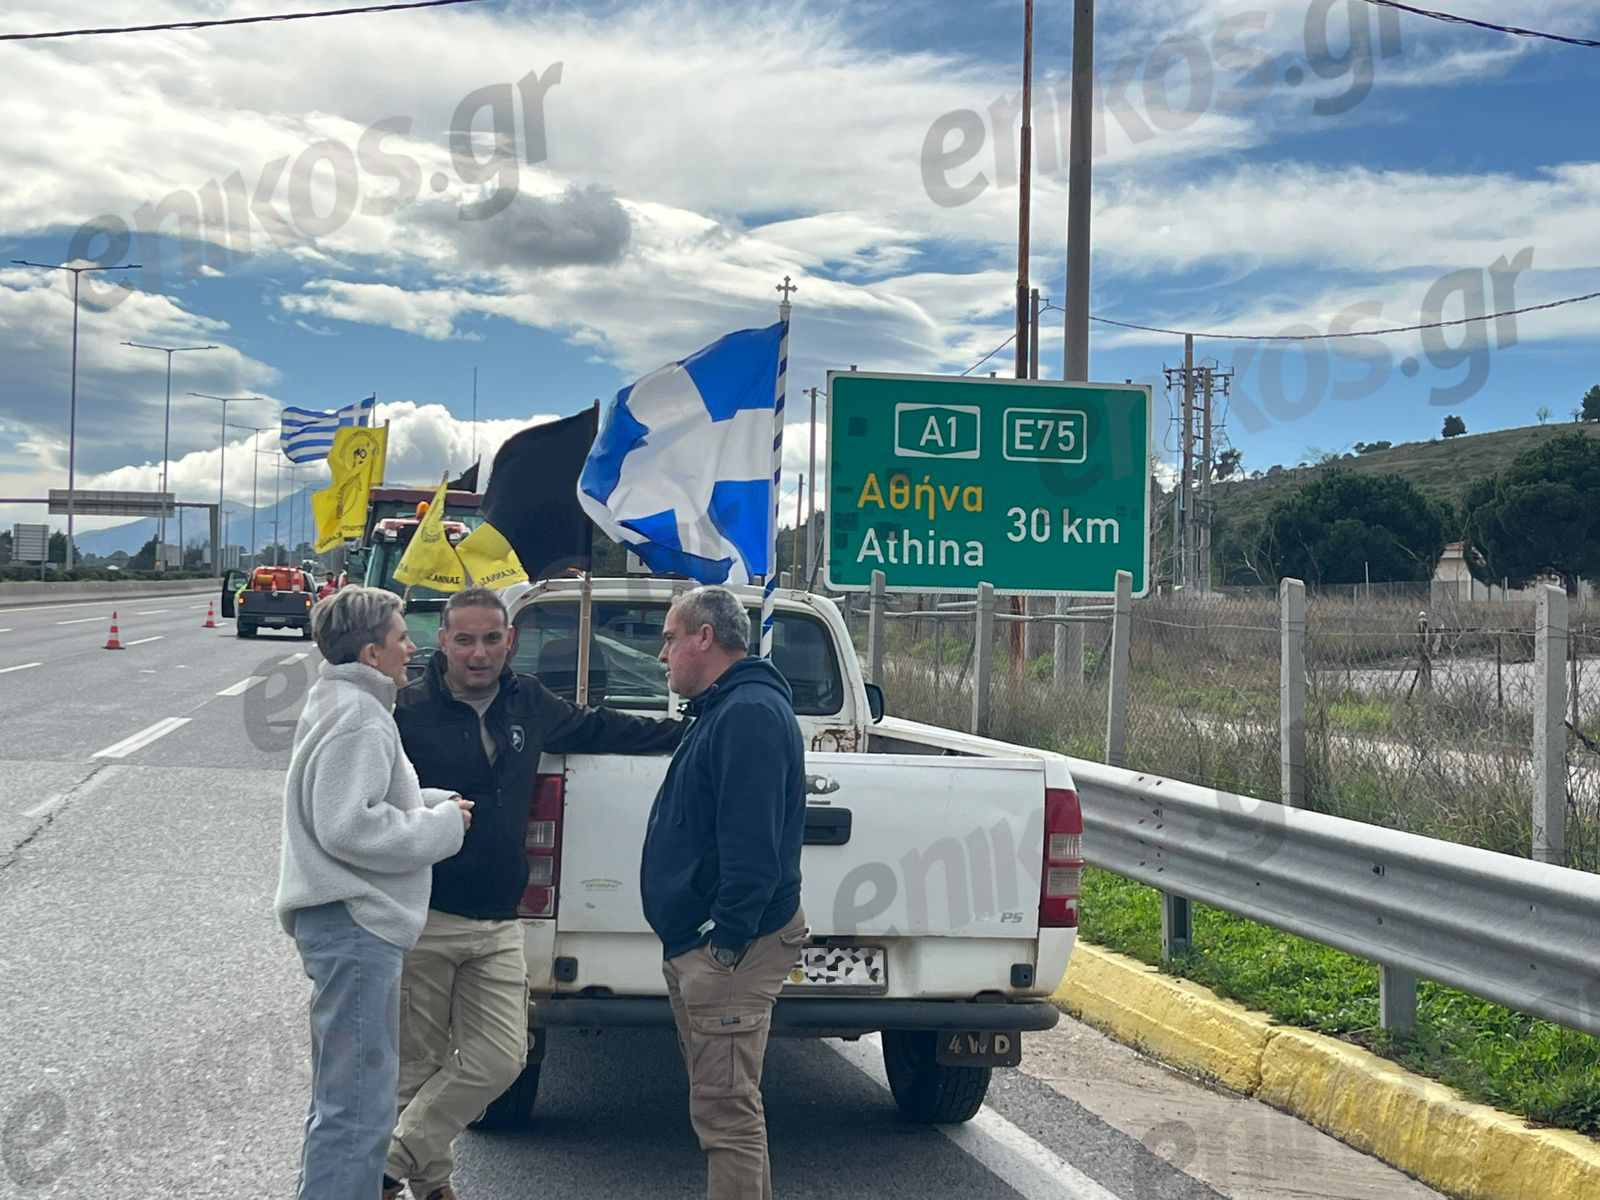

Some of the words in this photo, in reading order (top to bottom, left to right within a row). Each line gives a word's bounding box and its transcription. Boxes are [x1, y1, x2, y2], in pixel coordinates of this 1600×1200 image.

[920, 415, 957, 448] A1
[1014, 418, 1076, 452] E75
[857, 472, 983, 521] Αθήνα
[1006, 506, 1051, 543] 30
[1062, 508, 1120, 544] km
[856, 527, 984, 567] Athina
